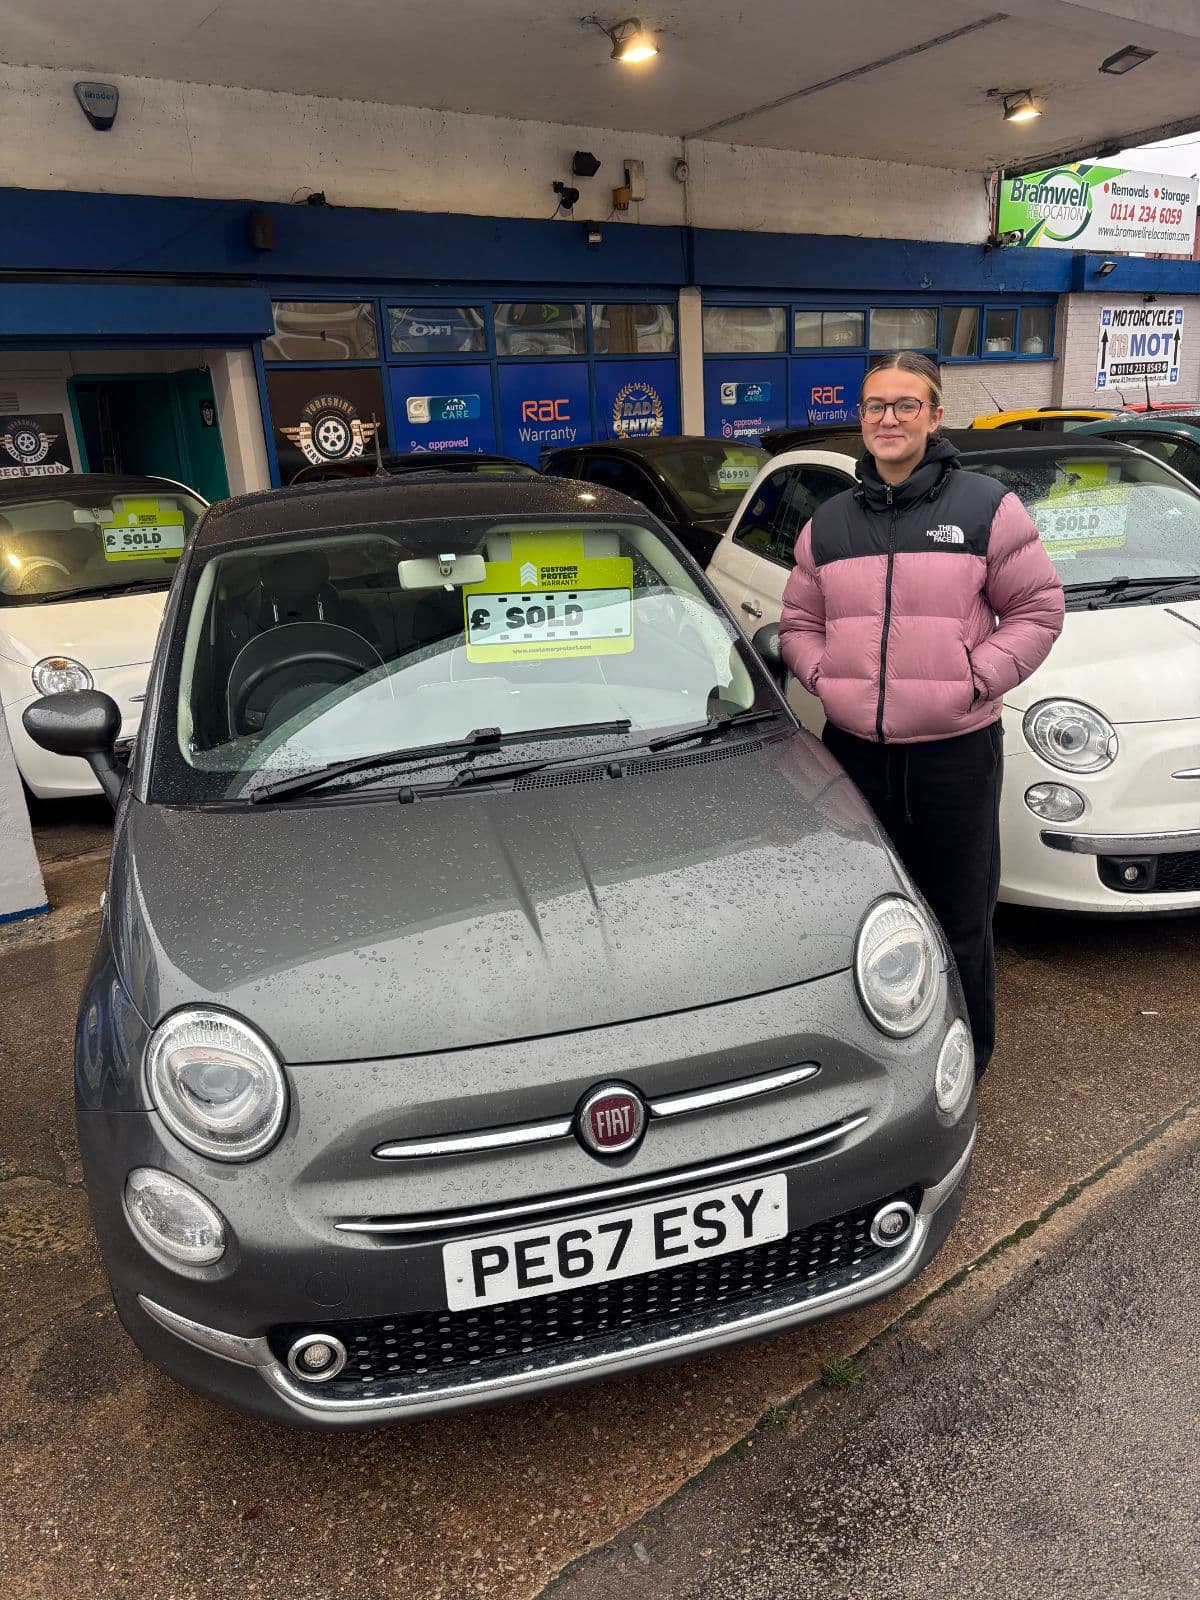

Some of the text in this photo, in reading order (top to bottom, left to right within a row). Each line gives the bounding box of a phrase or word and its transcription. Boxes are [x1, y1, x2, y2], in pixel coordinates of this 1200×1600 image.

[1010, 177, 1090, 207] Bramwell
[1111, 182, 1190, 206] Removals Storage
[1027, 202, 1084, 221] RELOCATION
[1110, 203, 1183, 225] 0114 234 6059
[1097, 225, 1190, 242] www.bramwellrelocation.com
[1112, 309, 1174, 327] MOTORCYCLE
[1130, 333, 1174, 357] MOT
[1117, 364, 1133, 374] 0114
[1134, 363, 1146, 374] 233
[304, 397, 354, 416] YORKSHIRE
[441, 410, 470, 419] CARE
[808, 408, 848, 422] Warranty
[613, 417, 664, 433] CENTRE
[733, 417, 762, 428] approved
[428, 436, 469, 450] approved
[518, 426, 577, 443] Warranty
[1054, 514, 1100, 532] SOLD
[106, 532, 162, 546] £ SOLD
[540, 565, 578, 573] CUSTOMER
[540, 572, 578, 580] PROTECT
[541, 579, 579, 587] WARRANTY
[470, 604, 584, 631] £ SOLD
[595, 1105, 632, 1139] FIAT
[470, 1188, 765, 1298] PE67 ESY
